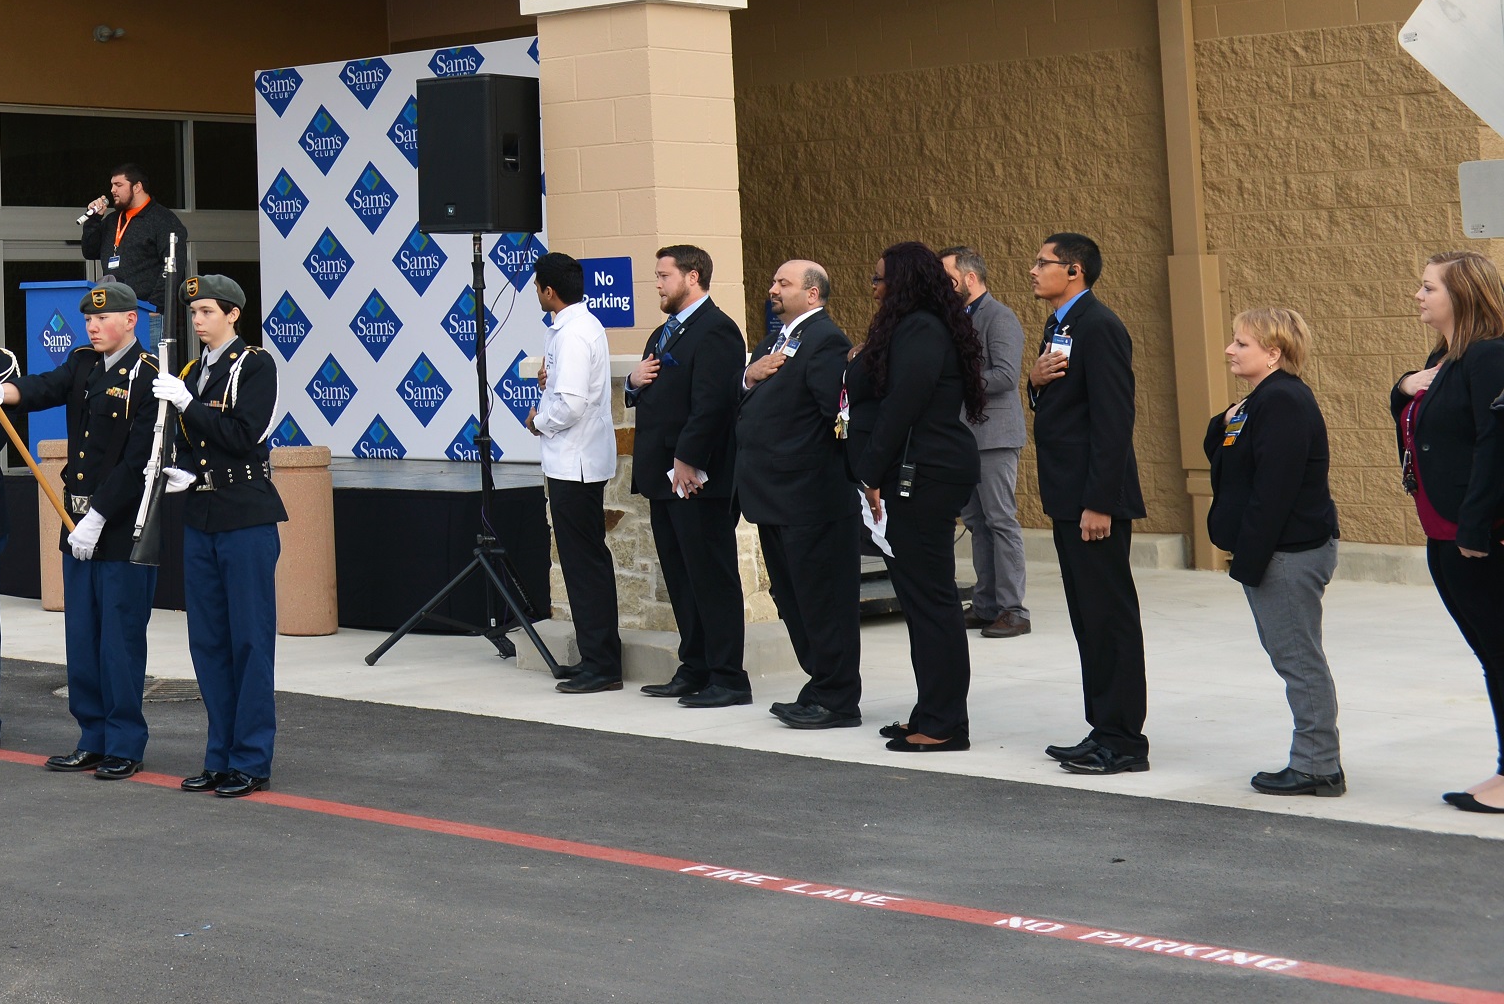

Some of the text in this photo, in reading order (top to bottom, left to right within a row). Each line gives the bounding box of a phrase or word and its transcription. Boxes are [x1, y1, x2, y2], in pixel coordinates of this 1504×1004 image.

[436, 54, 476, 74] Sam's
[261, 75, 296, 94] Sam's
[347, 65, 384, 85] Sam's
[306, 132, 342, 152] Sam's
[266, 194, 302, 214] Sam's
[353, 189, 391, 209] Sam's
[310, 254, 347, 274] Sam's
[400, 250, 439, 271] Sam's
[594, 271, 614, 286] No
[269, 316, 305, 336] Sam's
[357, 316, 395, 336] Sam's
[43, 330, 72, 347] Sam's
[313, 379, 350, 400] Sam's
[404, 380, 444, 400] Sam's
[679, 863, 1297, 971] FIRE LANE NO PARKING
